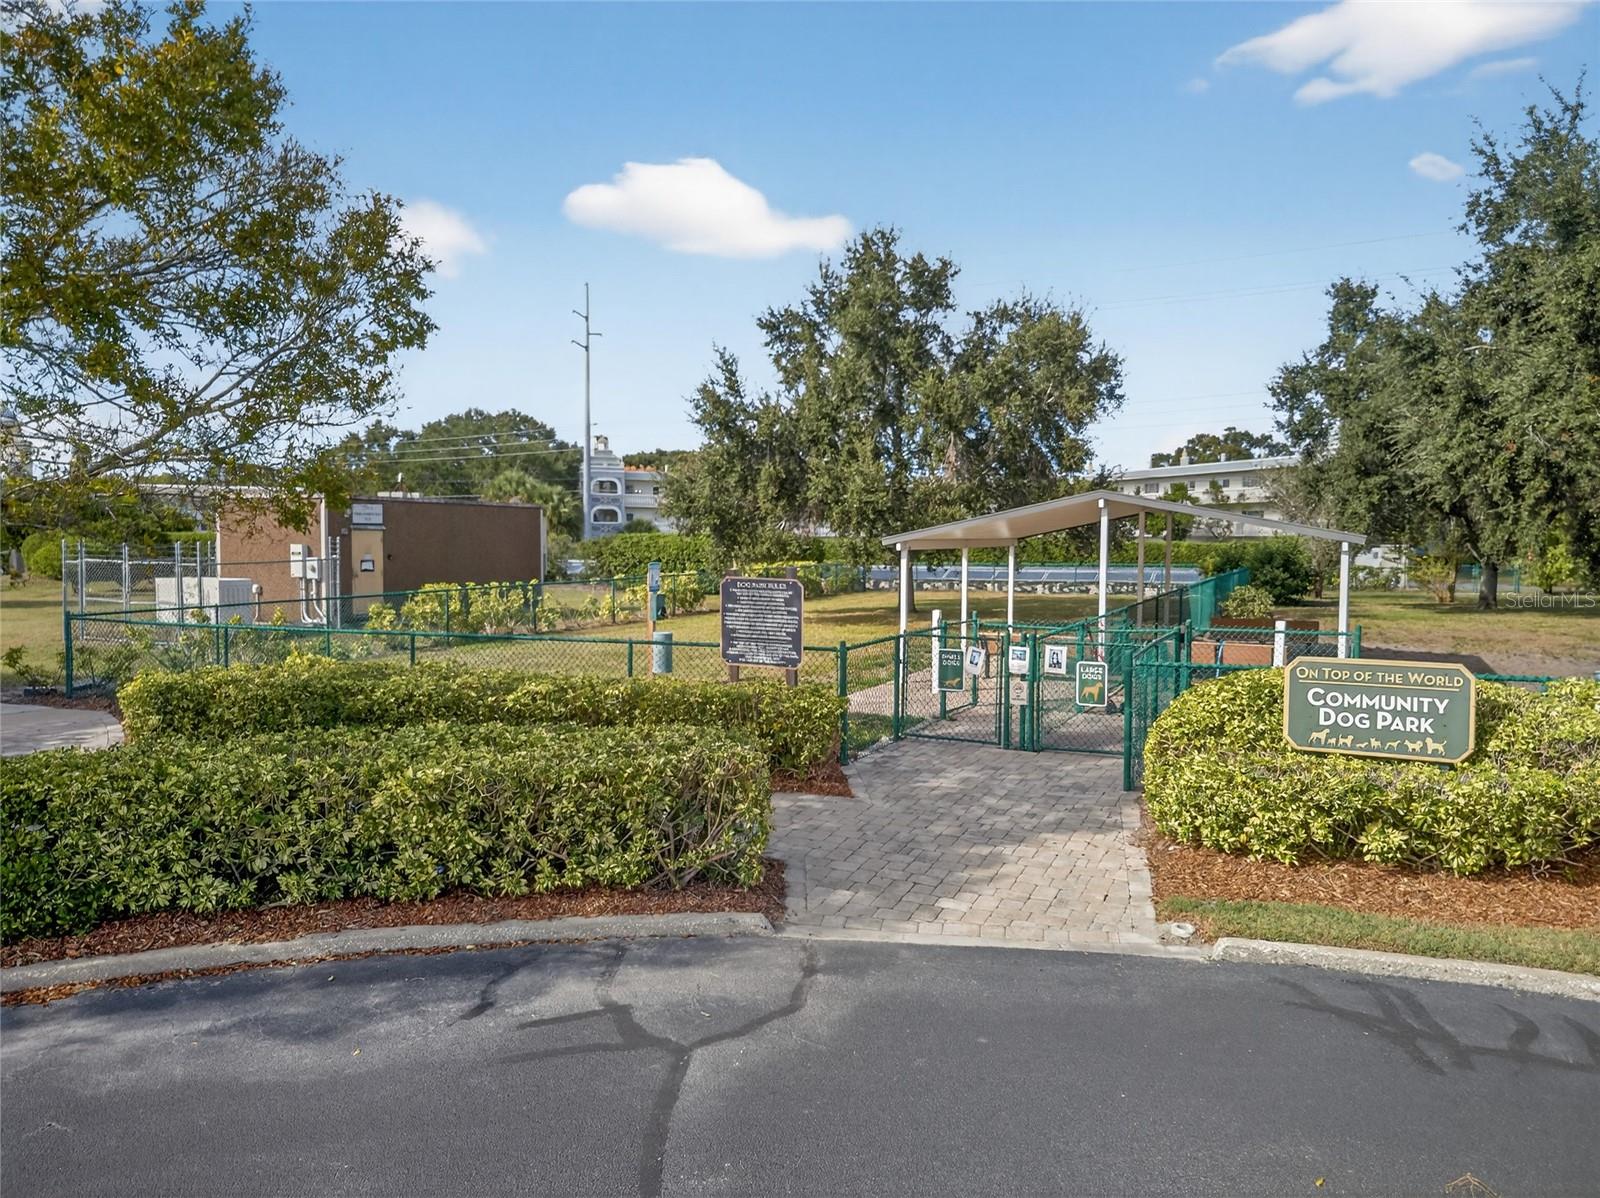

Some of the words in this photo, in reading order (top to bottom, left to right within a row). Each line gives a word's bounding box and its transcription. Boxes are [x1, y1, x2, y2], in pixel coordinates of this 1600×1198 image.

[1296, 666, 1318, 679] ON
[1322, 667, 1351, 682] TOP
[1353, 671, 1373, 682] OF
[1376, 672, 1404, 684] THE
[1408, 672, 1464, 688] WORLD
[1307, 687, 1450, 714] COMMUNITY
[1318, 707, 1371, 729] DOG
[1376, 711, 1435, 734] PARK
